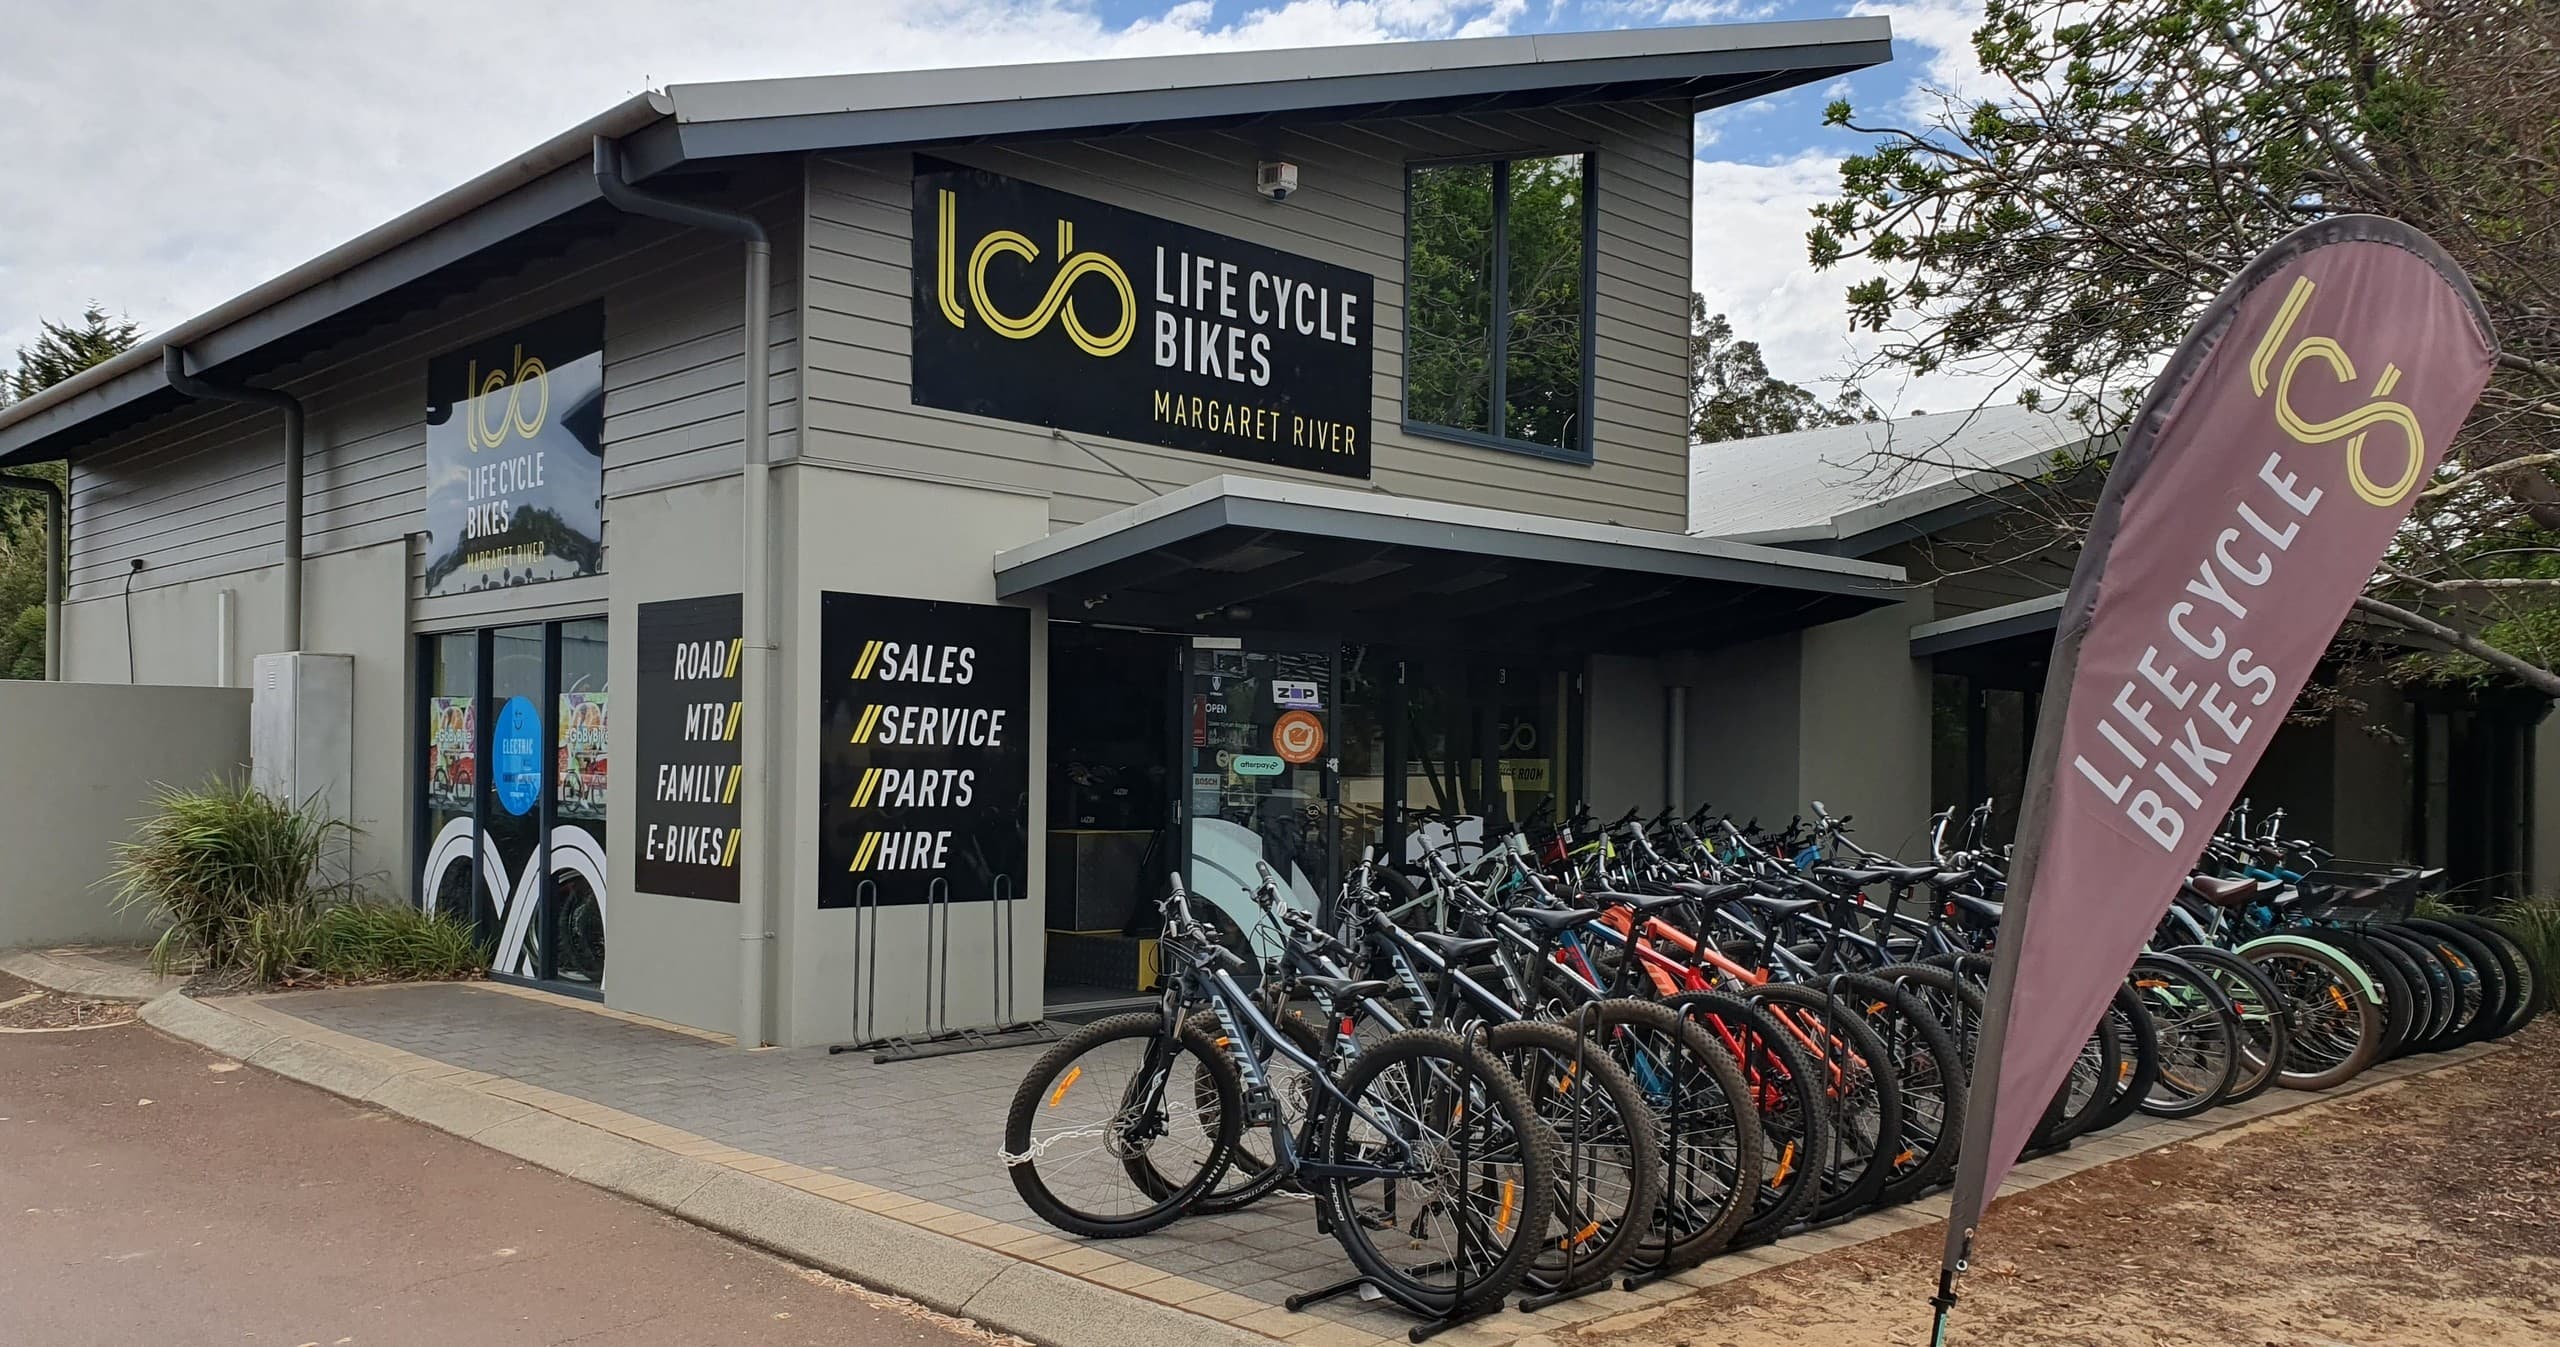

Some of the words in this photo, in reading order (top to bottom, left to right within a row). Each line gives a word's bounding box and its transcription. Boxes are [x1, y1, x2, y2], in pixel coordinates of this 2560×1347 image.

[1155, 245, 1238, 320] LIFE
[1248, 270, 1358, 346] CYCLE
[1154, 311, 1271, 388] BIKES
[1154, 389, 1281, 444] MARGARET
[1292, 414, 1357, 457] RIVER
[466, 463, 497, 501] LIFE
[499, 451, 545, 495] CYCLE
[467, 499, 510, 540] BIKES
[466, 545, 514, 573] MARGARET
[516, 540, 545, 563] RIVER
[2073, 645, 2199, 805] LIFE
[2167, 451, 2325, 661] CYCLE
[1205, 703, 1228, 714] OPEN
[1240, 761, 1270, 770] afterpay
[2125, 647, 2277, 853] BIKES
[1194, 777, 1219, 786] BOSCH
